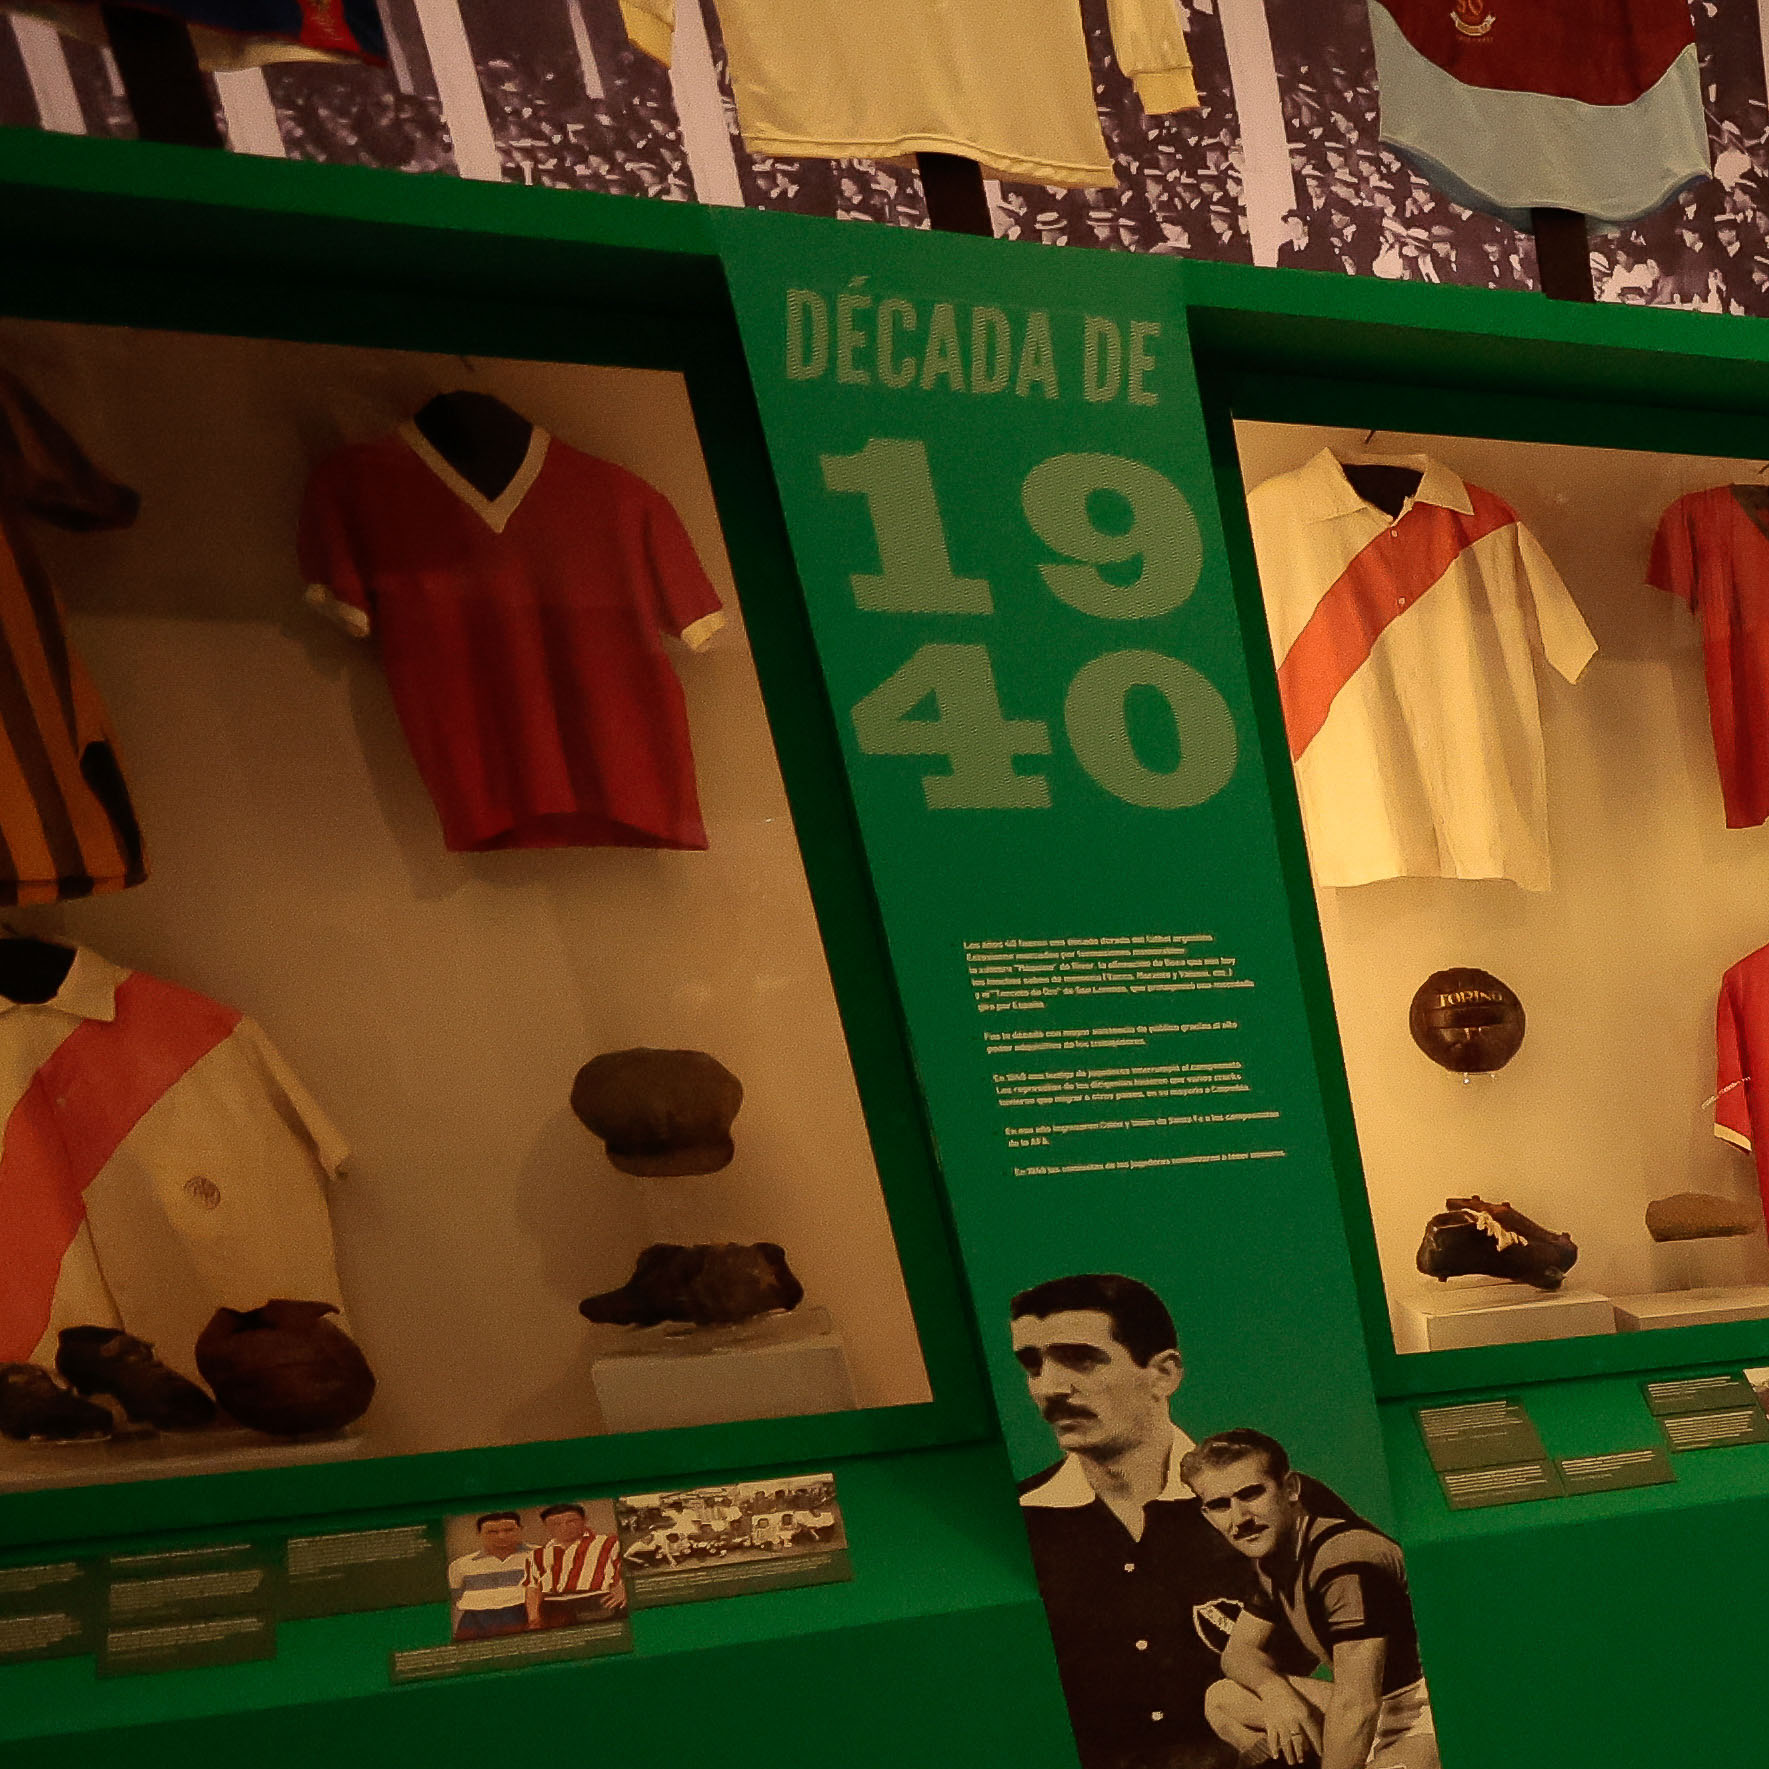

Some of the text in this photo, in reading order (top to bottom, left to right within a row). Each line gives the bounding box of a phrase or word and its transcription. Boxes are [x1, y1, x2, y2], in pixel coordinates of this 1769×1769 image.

[785, 275, 1162, 407] DÉCADA DE
[818, 438, 1203, 619] 19
[852, 643, 1238, 809] 40
[1440, 990, 1503, 1008] TORINO
